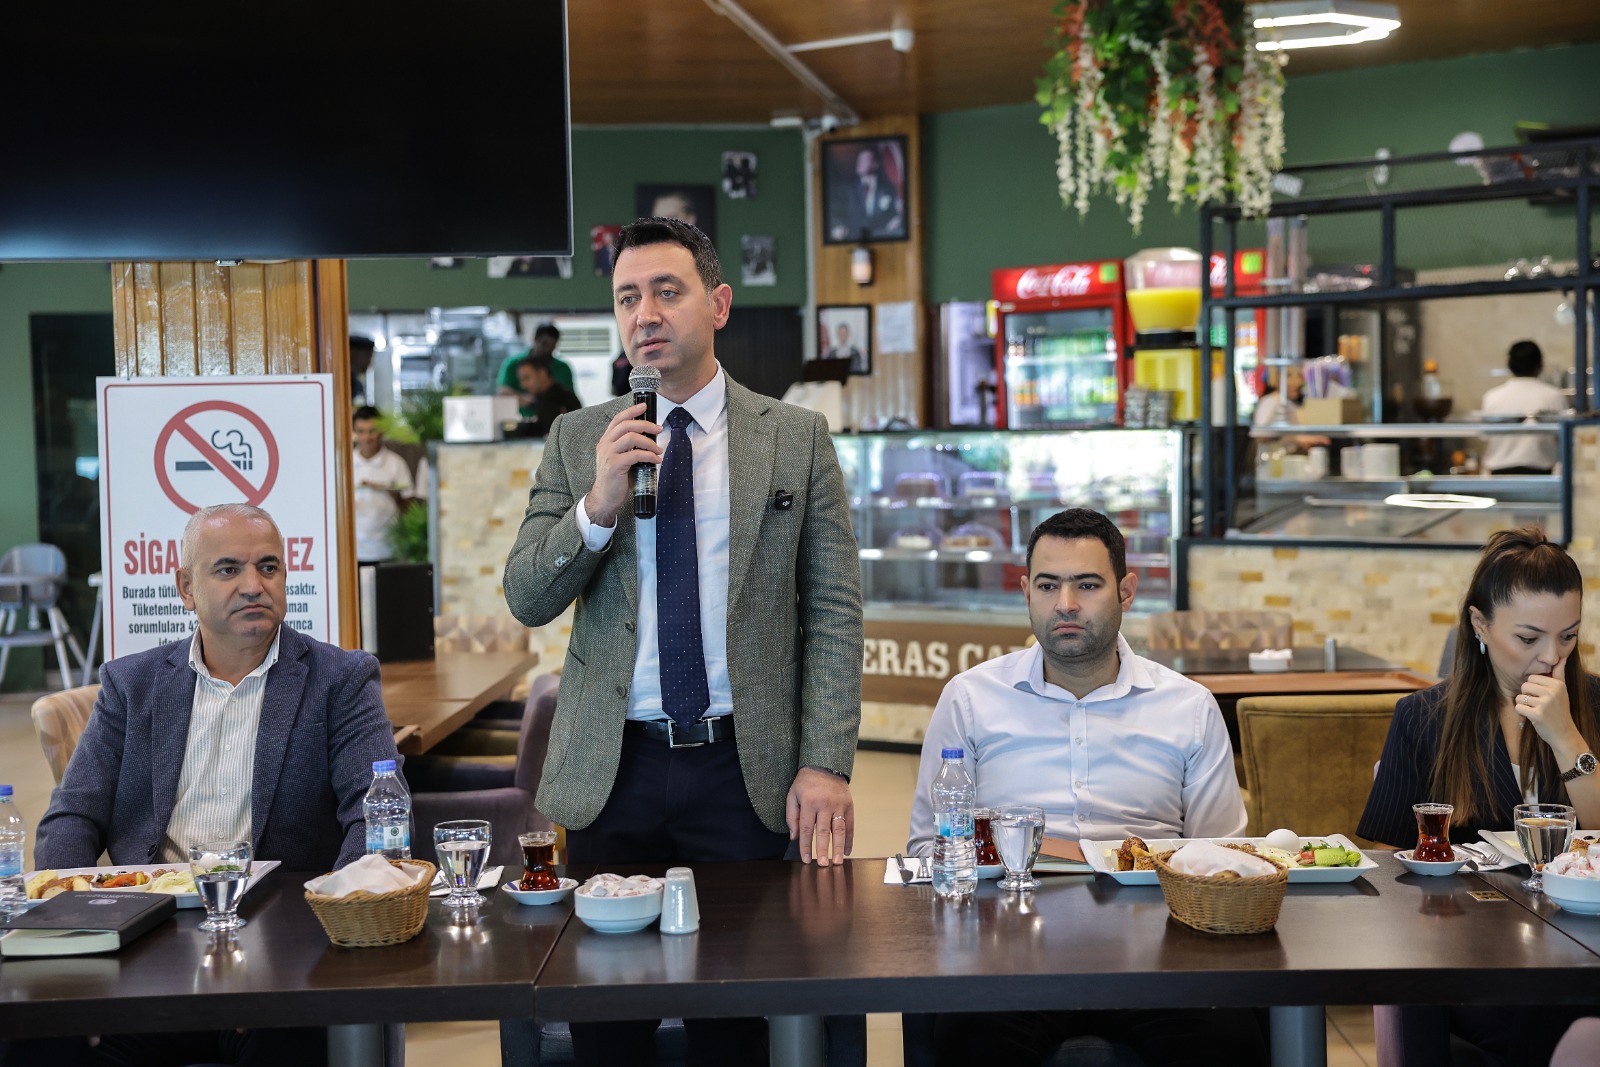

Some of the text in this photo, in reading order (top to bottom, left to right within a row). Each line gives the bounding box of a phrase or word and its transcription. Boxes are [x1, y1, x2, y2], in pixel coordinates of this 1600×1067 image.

[124, 532, 184, 575] SİGA
[122, 586, 156, 599] Burada
[158, 585, 181, 598] tütü
[128, 620, 186, 634] sorumlulara
